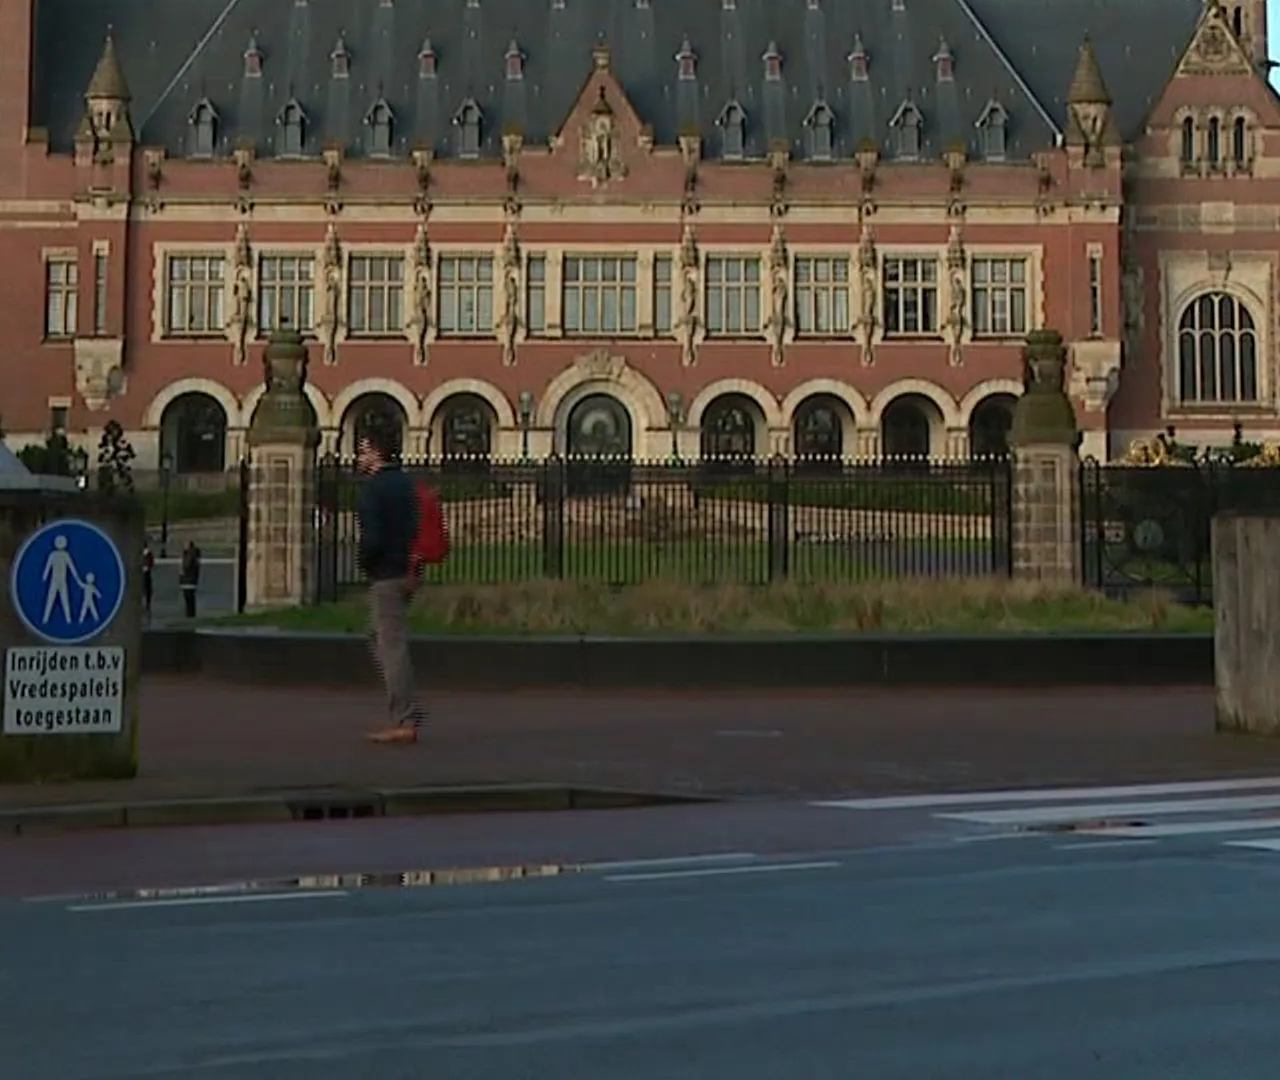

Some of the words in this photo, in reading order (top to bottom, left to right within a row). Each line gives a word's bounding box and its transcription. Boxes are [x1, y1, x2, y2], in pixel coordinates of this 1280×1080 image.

[11, 651, 79, 675] Inrijden
[10, 677, 119, 702] Vredespaleis
[16, 706, 111, 730] toegestaan
